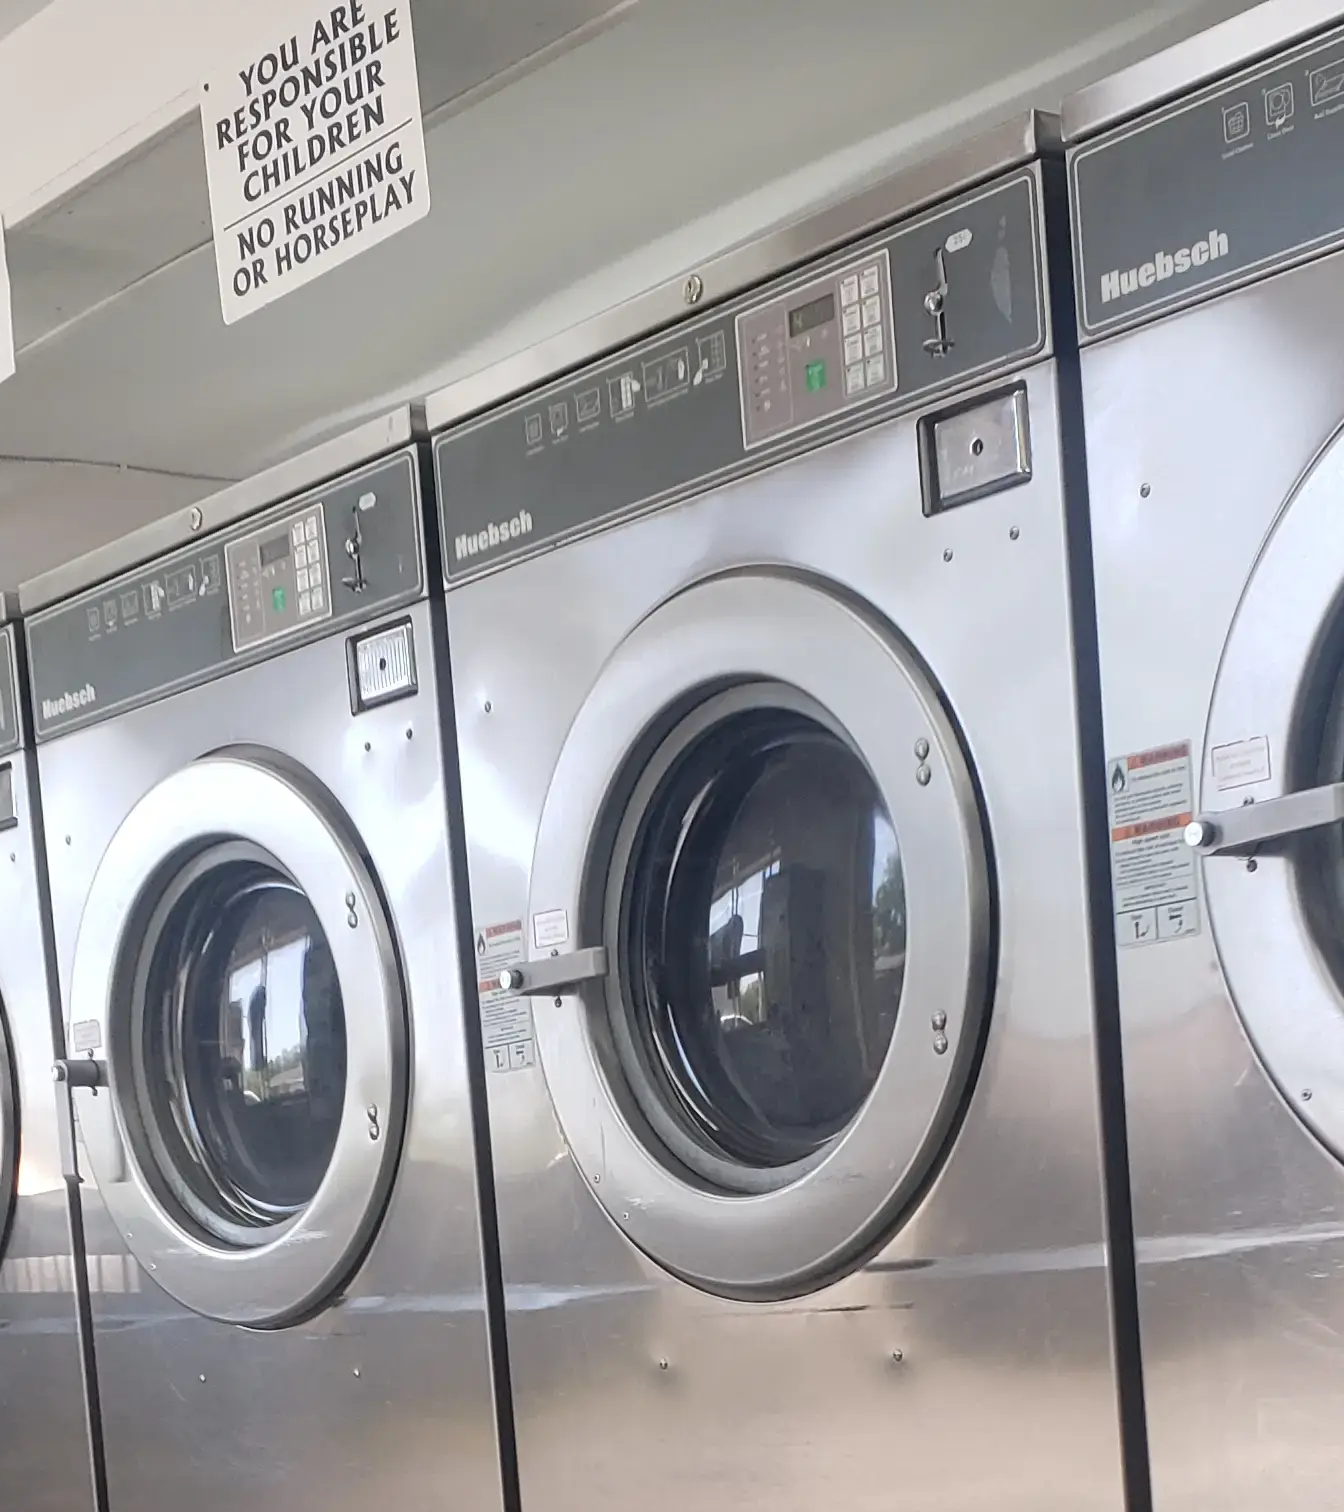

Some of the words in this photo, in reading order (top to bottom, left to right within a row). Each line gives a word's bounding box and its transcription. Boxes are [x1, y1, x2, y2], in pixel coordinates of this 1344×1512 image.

[216, 8, 400, 150] RESPONSIBLE
[238, 35, 299, 97] YOU
[311, 0, 365, 55] ARE
[237, 117, 294, 173] FOR
[300, 59, 386, 131] YOUR
[243, 94, 385, 202] CHILDREN
[233, 258, 268, 297] OR
[275, 169, 415, 276] HORSEPLAY
[237, 218, 275, 261] NO
[283, 142, 403, 235] RUNNING
[1101, 229, 1230, 303] Huebsch
[455, 510, 533, 561] Huebsch
